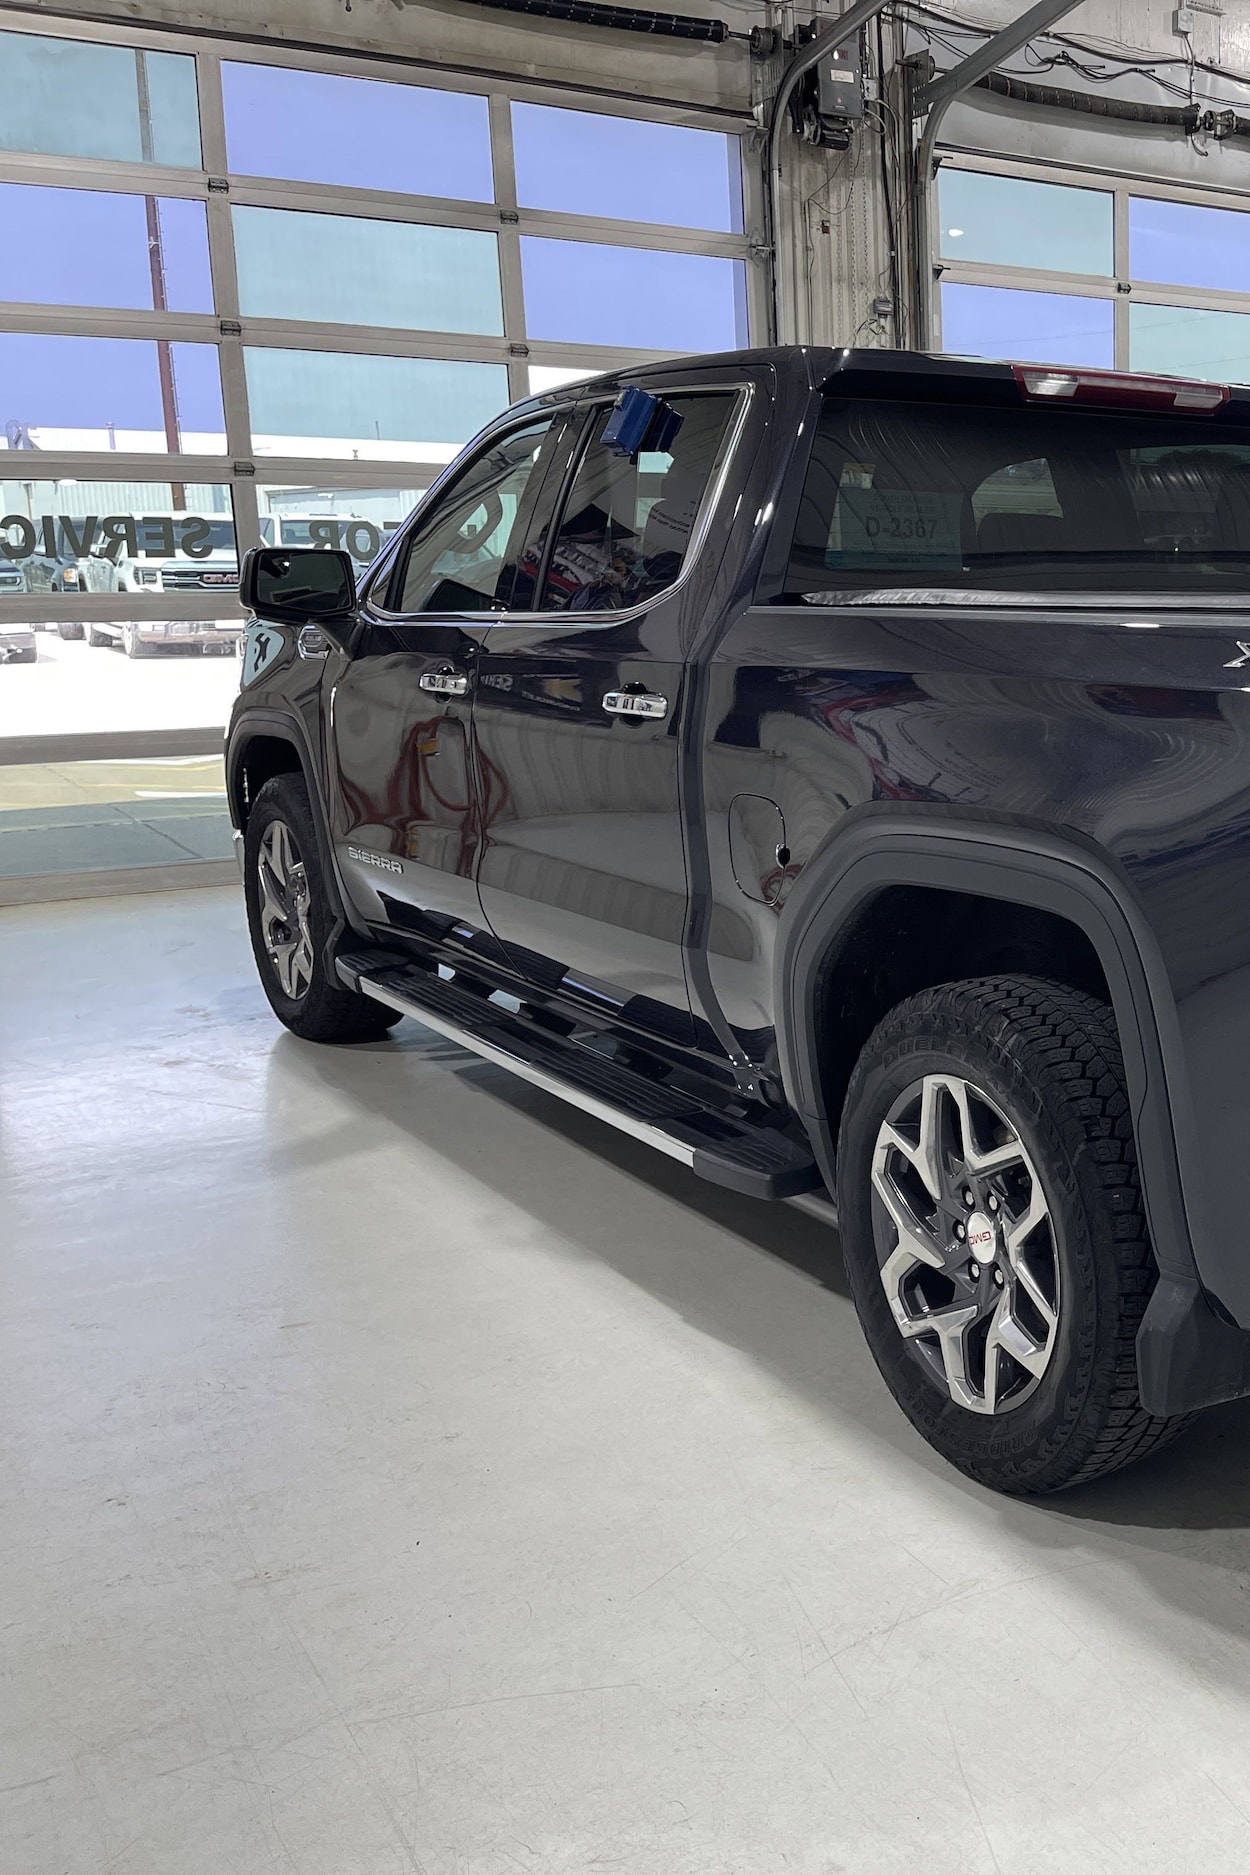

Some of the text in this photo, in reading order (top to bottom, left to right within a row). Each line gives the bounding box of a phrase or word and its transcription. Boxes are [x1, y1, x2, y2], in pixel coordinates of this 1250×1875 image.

[865, 516, 938, 538] D-2367
[347, 846, 404, 874] SIERRA
[969, 1231, 992, 1246] GMC
